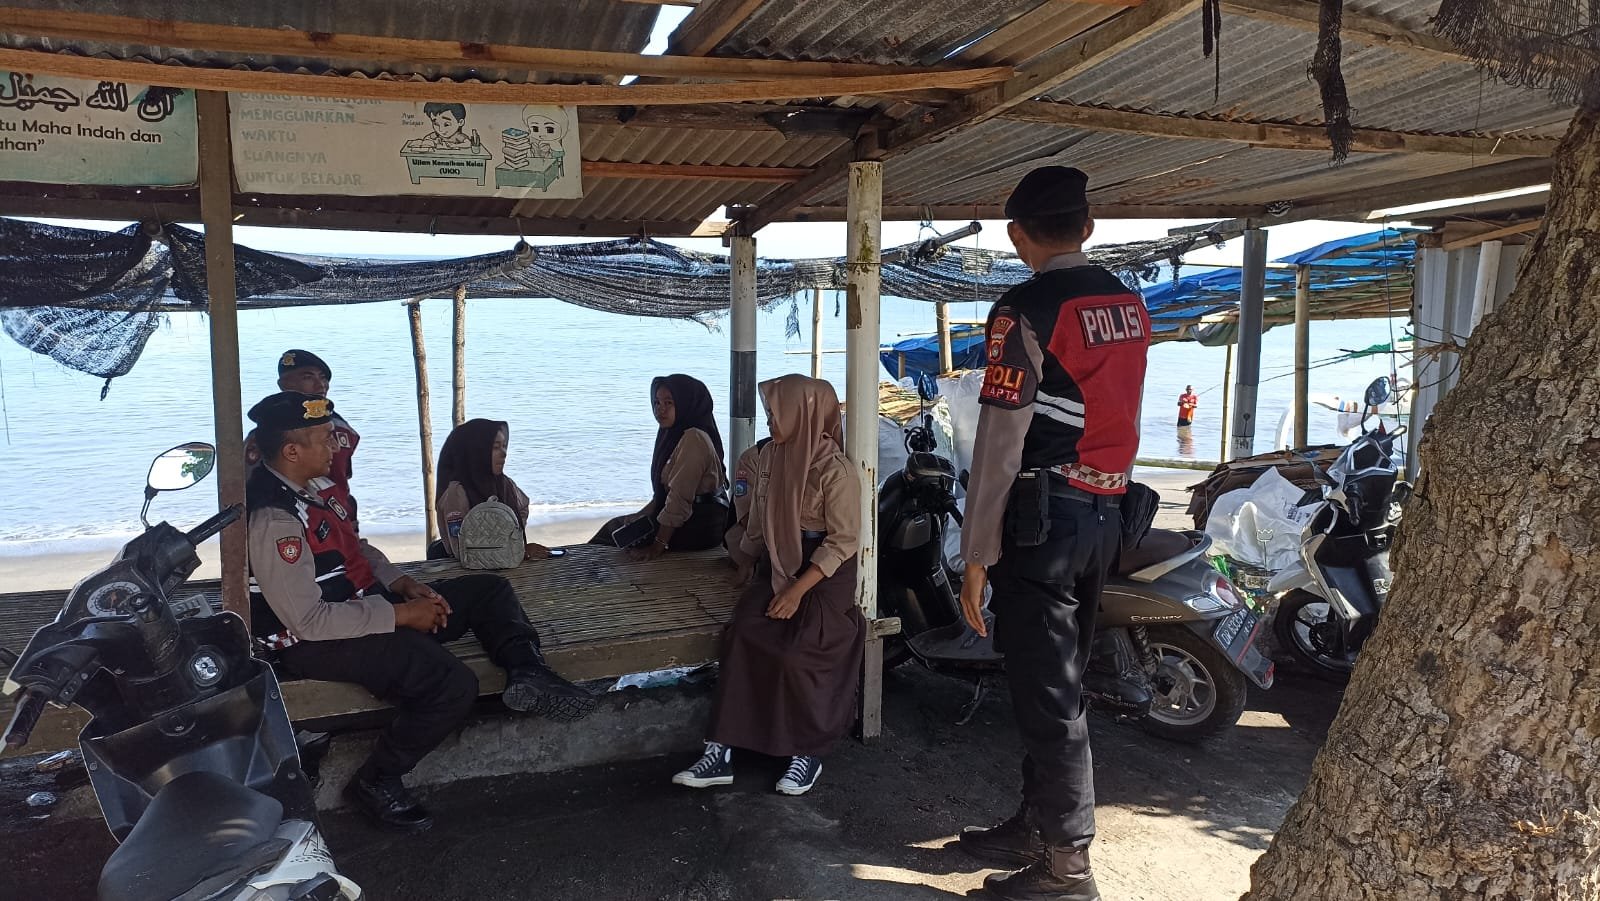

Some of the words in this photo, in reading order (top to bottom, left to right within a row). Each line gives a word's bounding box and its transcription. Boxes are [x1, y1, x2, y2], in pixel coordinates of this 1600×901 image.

[240, 109, 356, 123] MENGGUNAKAN
[22, 120, 72, 135] Maha
[77, 123, 125, 140] Indah
[130, 129, 162, 143] dan
[241, 129, 297, 143] WAKTU
[243, 150, 328, 164] LUANGNYA
[412, 159, 430, 167] Ujian
[432, 159, 465, 168] Kenaikan
[246, 171, 296, 184] UNTUK
[301, 172, 362, 187] BELAJAR
[440, 168, 460, 176] (UKK)
[1081, 303, 1145, 343] POLISI
